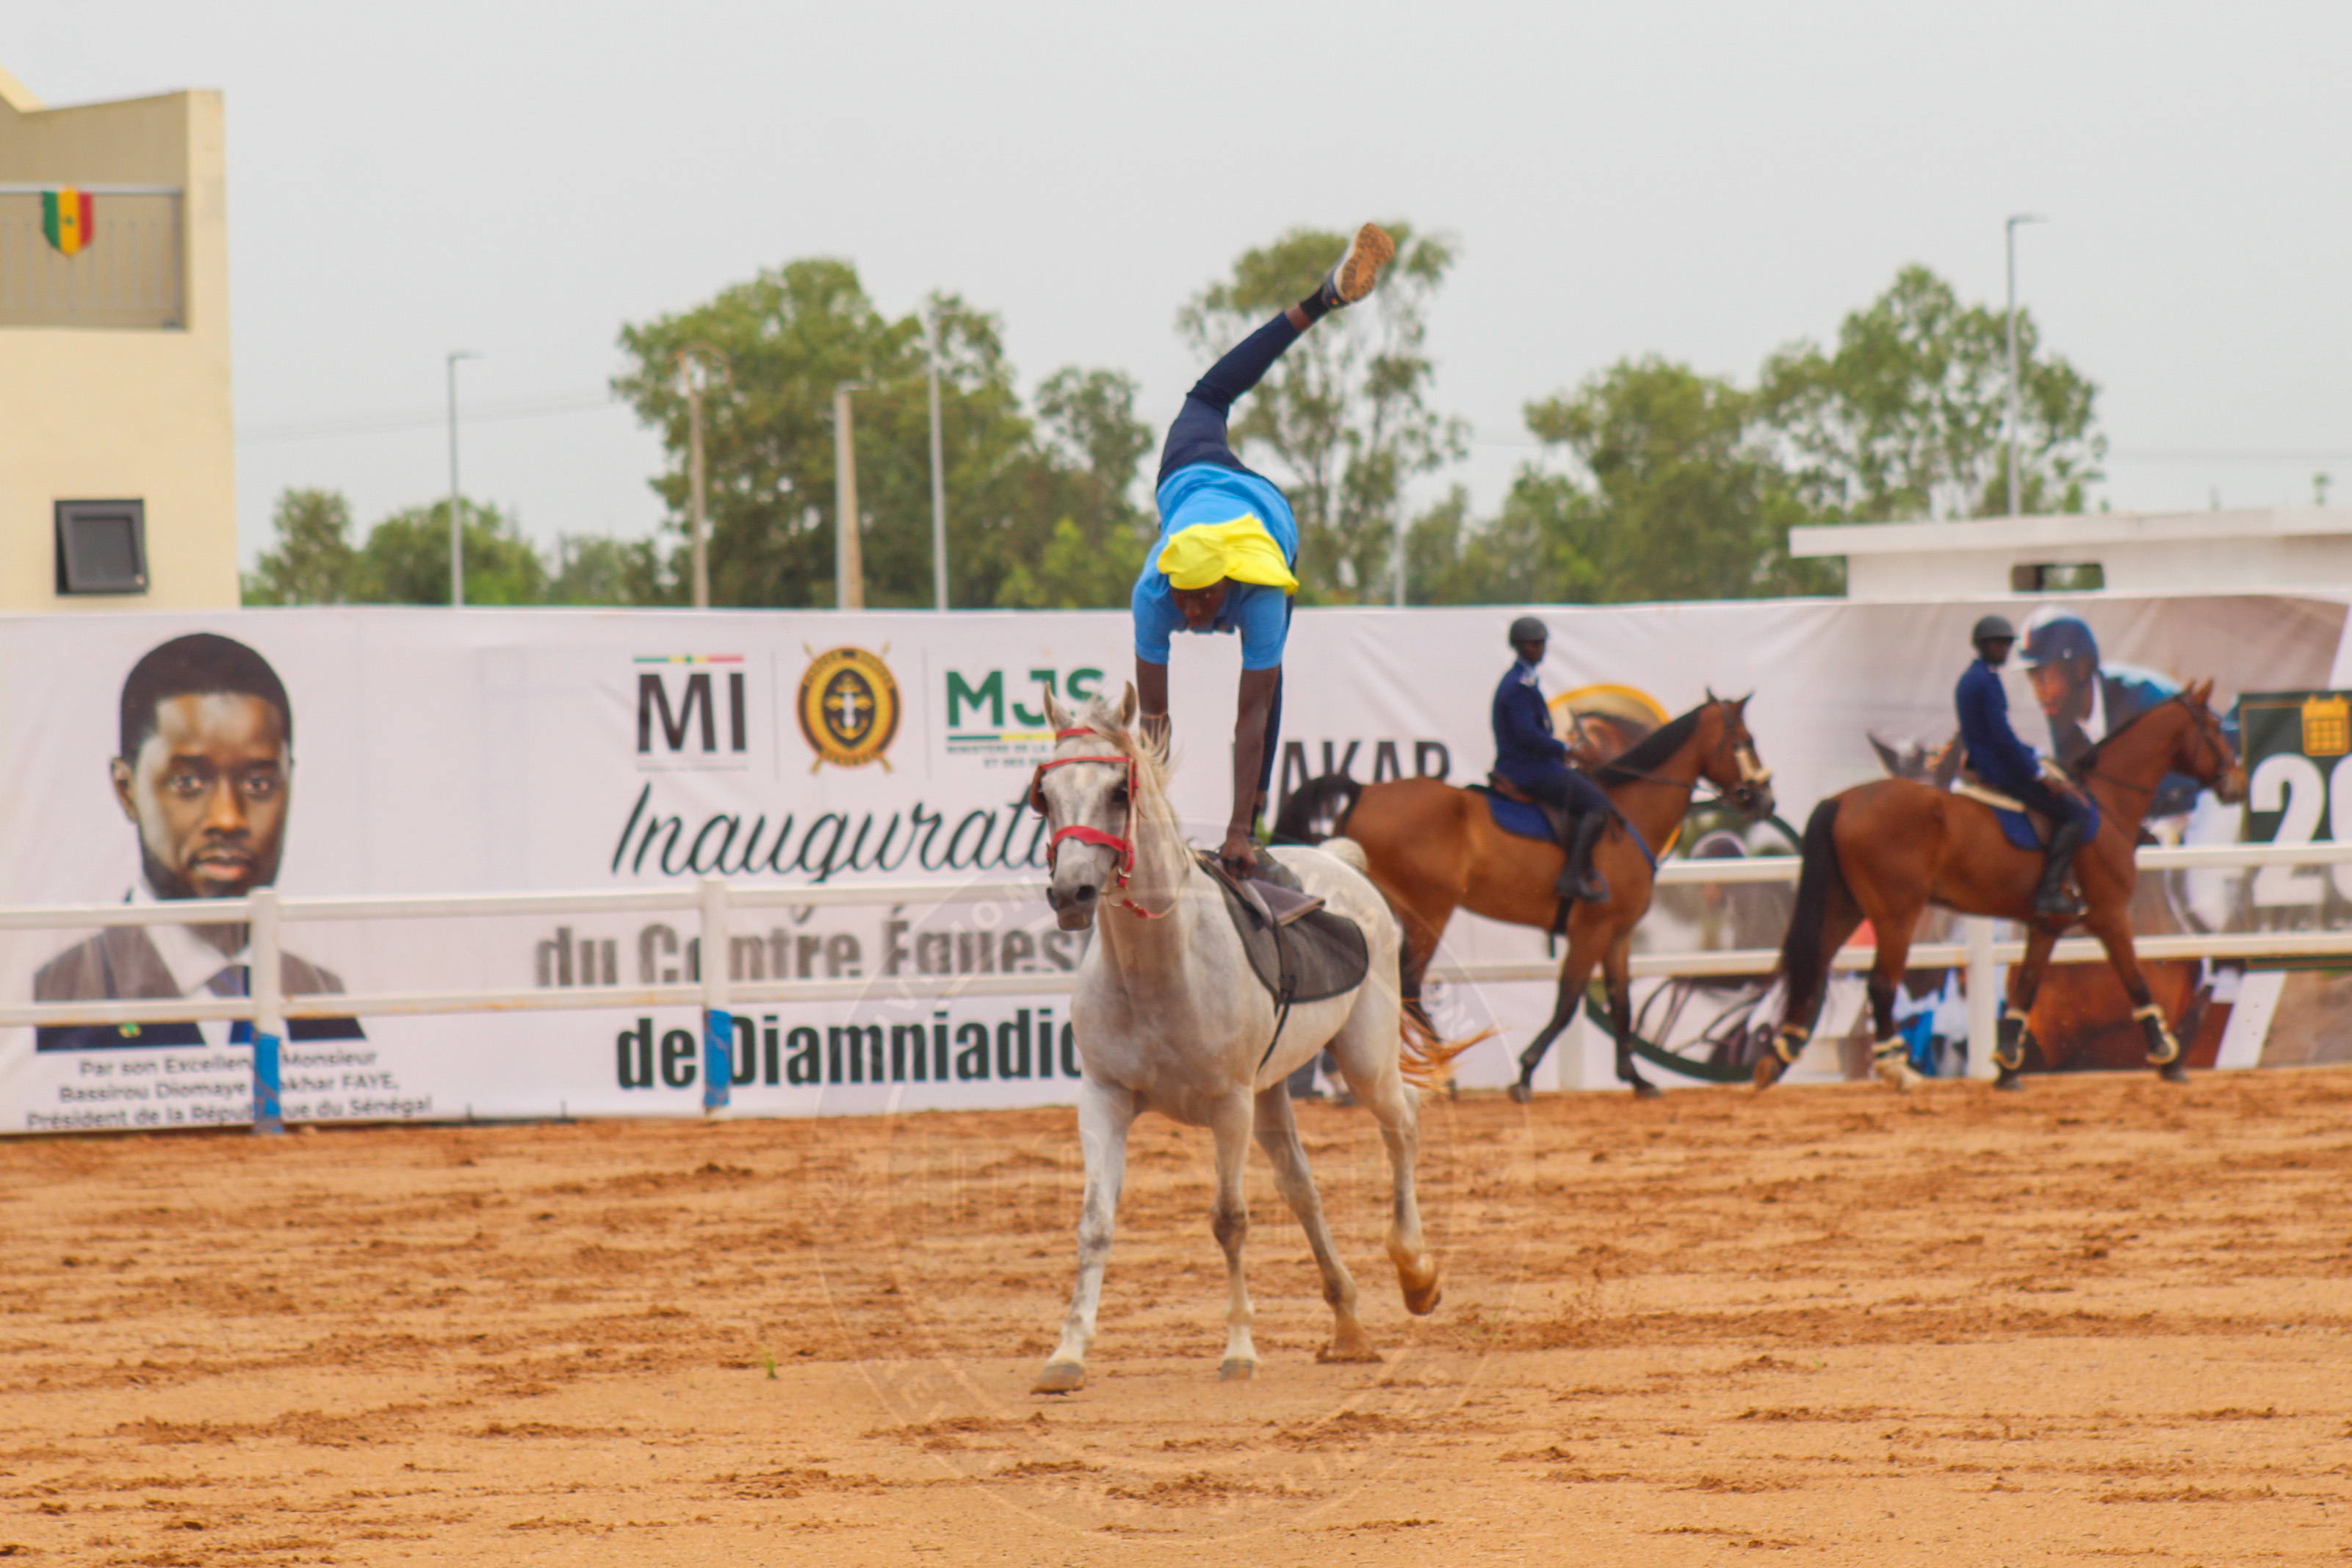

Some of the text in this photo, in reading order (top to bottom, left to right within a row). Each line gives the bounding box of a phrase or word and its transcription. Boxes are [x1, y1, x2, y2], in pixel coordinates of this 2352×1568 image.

[638, 673, 747, 753] MI
[946, 668, 1105, 727] MJS
[1232, 740, 1451, 787] AKAR
[612, 781, 1048, 884] Inaugurati
[536, 926, 618, 987] du
[79, 1049, 378, 1077] Par son Excellen Monsieur
[616, 1017, 697, 1090] de
[27, 1110, 128, 1130] Président
[134, 1108, 160, 1125] de
[167, 1107, 184, 1121] la
[317, 1100, 343, 1117] du
[350, 1094, 433, 1119] Sénégal
[59, 1086, 149, 1103] Bassirou
[156, 1081, 247, 1100] Diomaye
